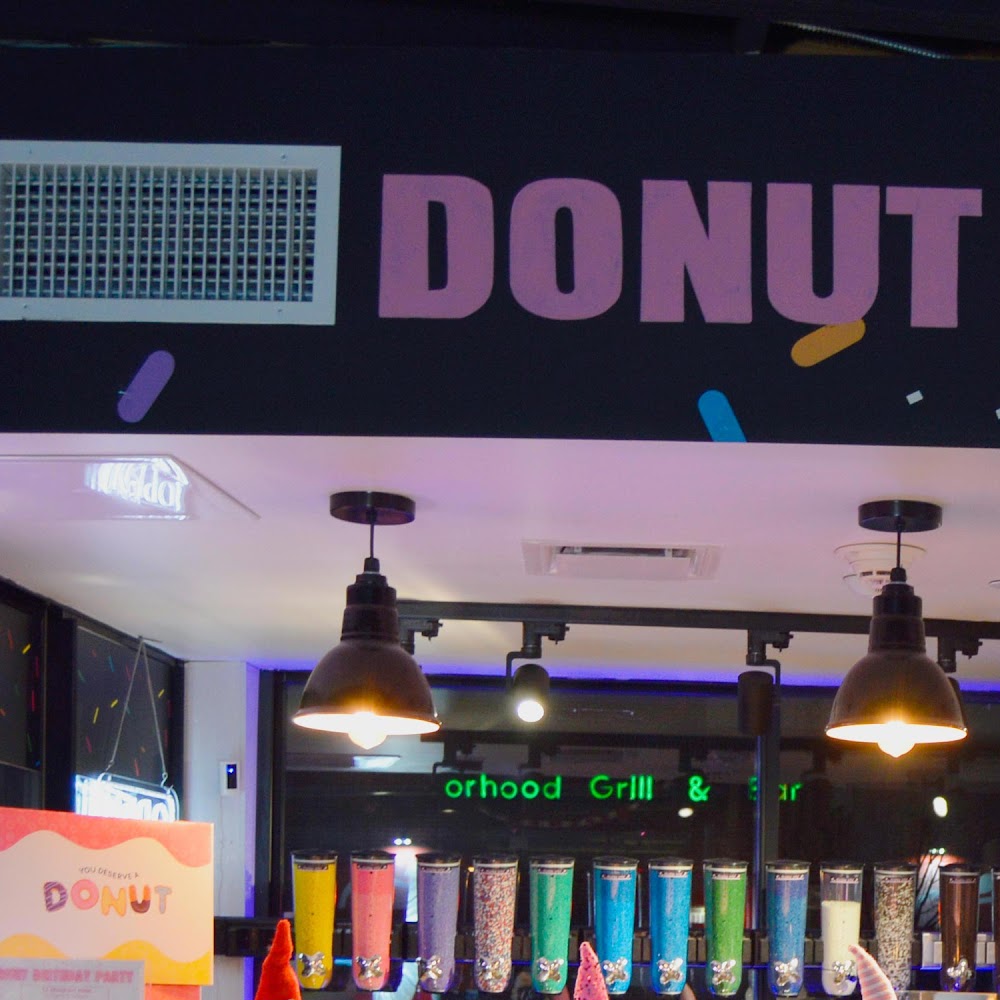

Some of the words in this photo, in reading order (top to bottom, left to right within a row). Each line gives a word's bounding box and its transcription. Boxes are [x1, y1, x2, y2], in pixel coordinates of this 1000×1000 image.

[378, 173, 983, 328] DONUT
[445, 774, 561, 799] orhood
[688, 775, 710, 801] &
[79, 866, 96, 874] YOU
[43, 879, 172, 917] DONUT
